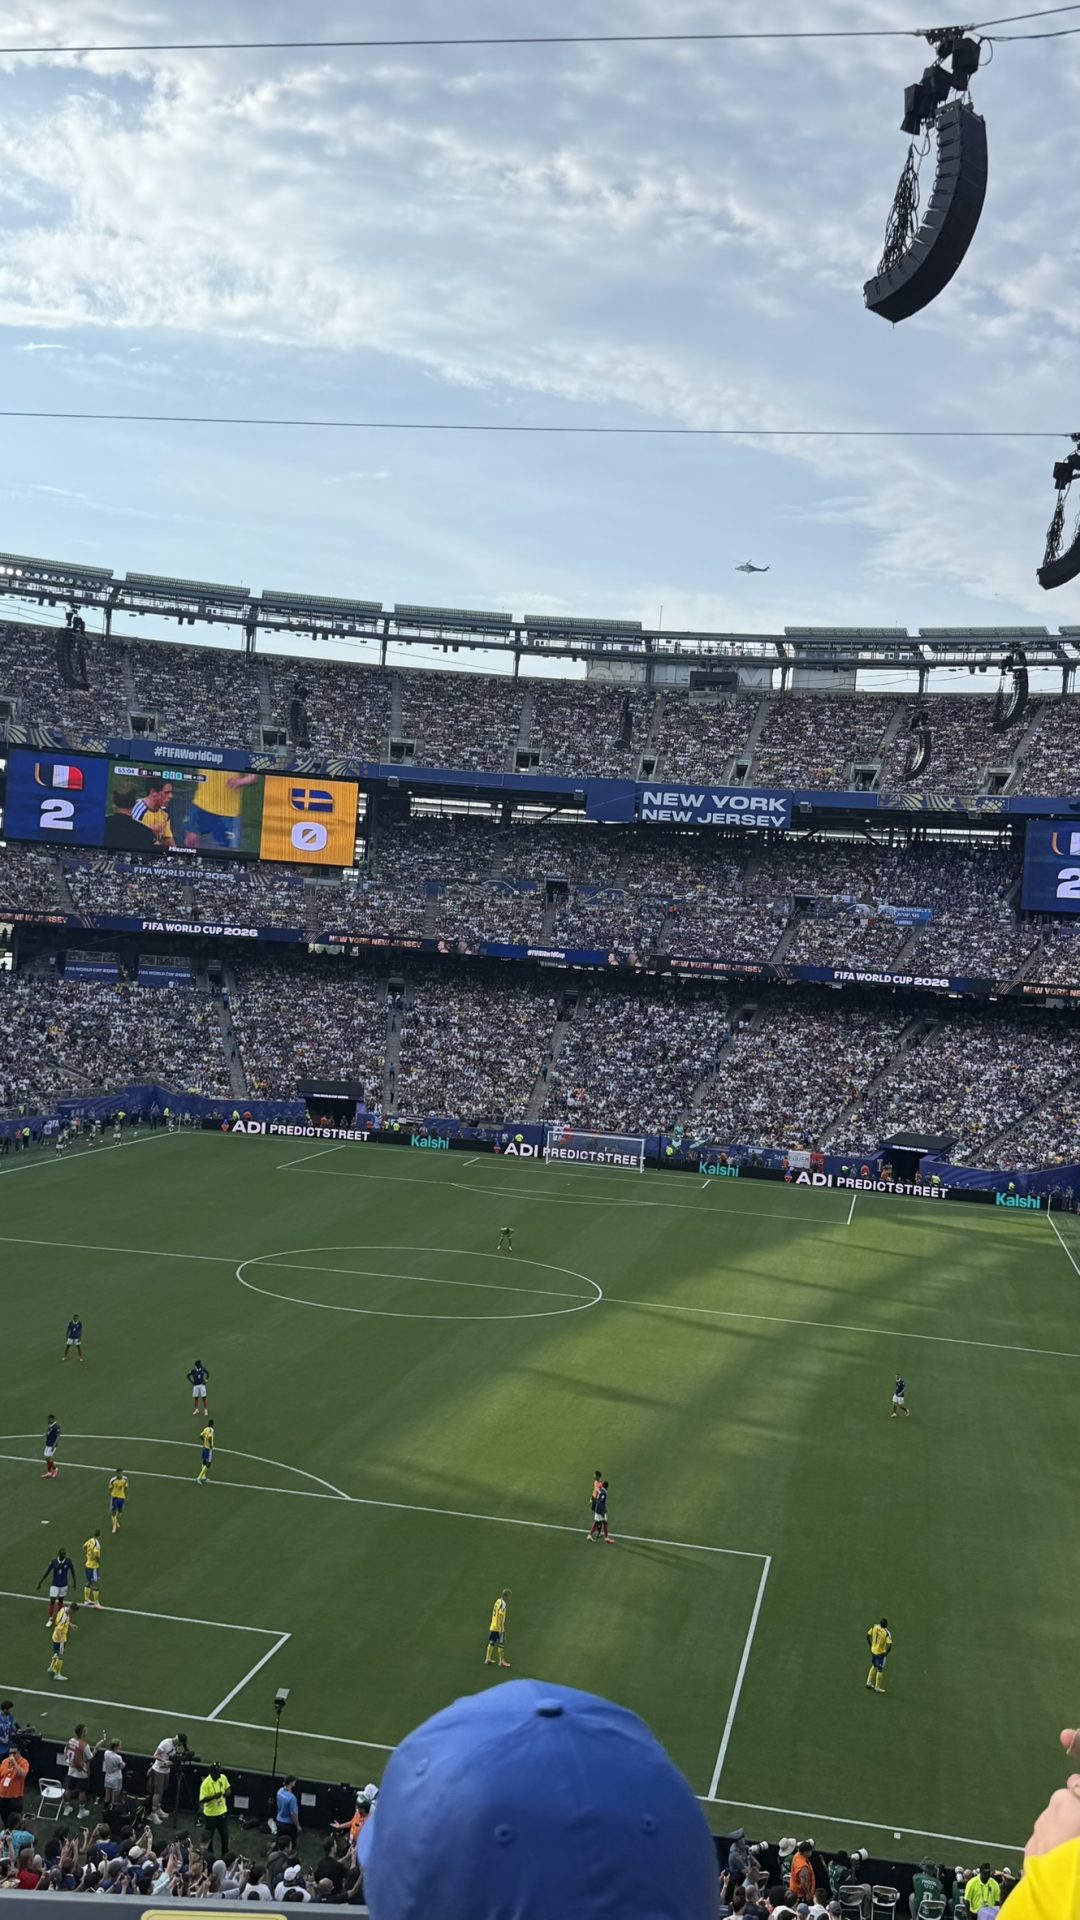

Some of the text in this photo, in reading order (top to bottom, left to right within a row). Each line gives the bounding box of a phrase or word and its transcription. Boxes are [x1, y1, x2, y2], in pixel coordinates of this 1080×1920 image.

[154, 746, 223, 764] #FIFAWorldCup
[642, 791, 788, 812] NEW YORK
[40, 798, 75, 830] 2
[641, 809, 786, 827] NEW JERSEY
[291, 821, 328, 852] 0
[168, 846, 197, 854] Hisense
[134, 866, 153, 875] FIFA
[153, 868, 185, 877] WORLD
[186, 871, 204, 879] CUP
[142, 921, 258, 937] FIFA WORLD CUP 2026
[834, 971, 949, 987] FIFA WORLD CUP 2026
[232, 1120, 370, 1142] ADI PREDICTSTREET
[411, 1134, 450, 1149] Kalshi
[504, 1142, 645, 1166] ADI PREDICTSTREET
[698, 1161, 739, 1177] Kalshi
[795, 1171, 949, 1198] ADI PREDICTSTREET
[995, 1191, 1041, 1209] Kalshi
